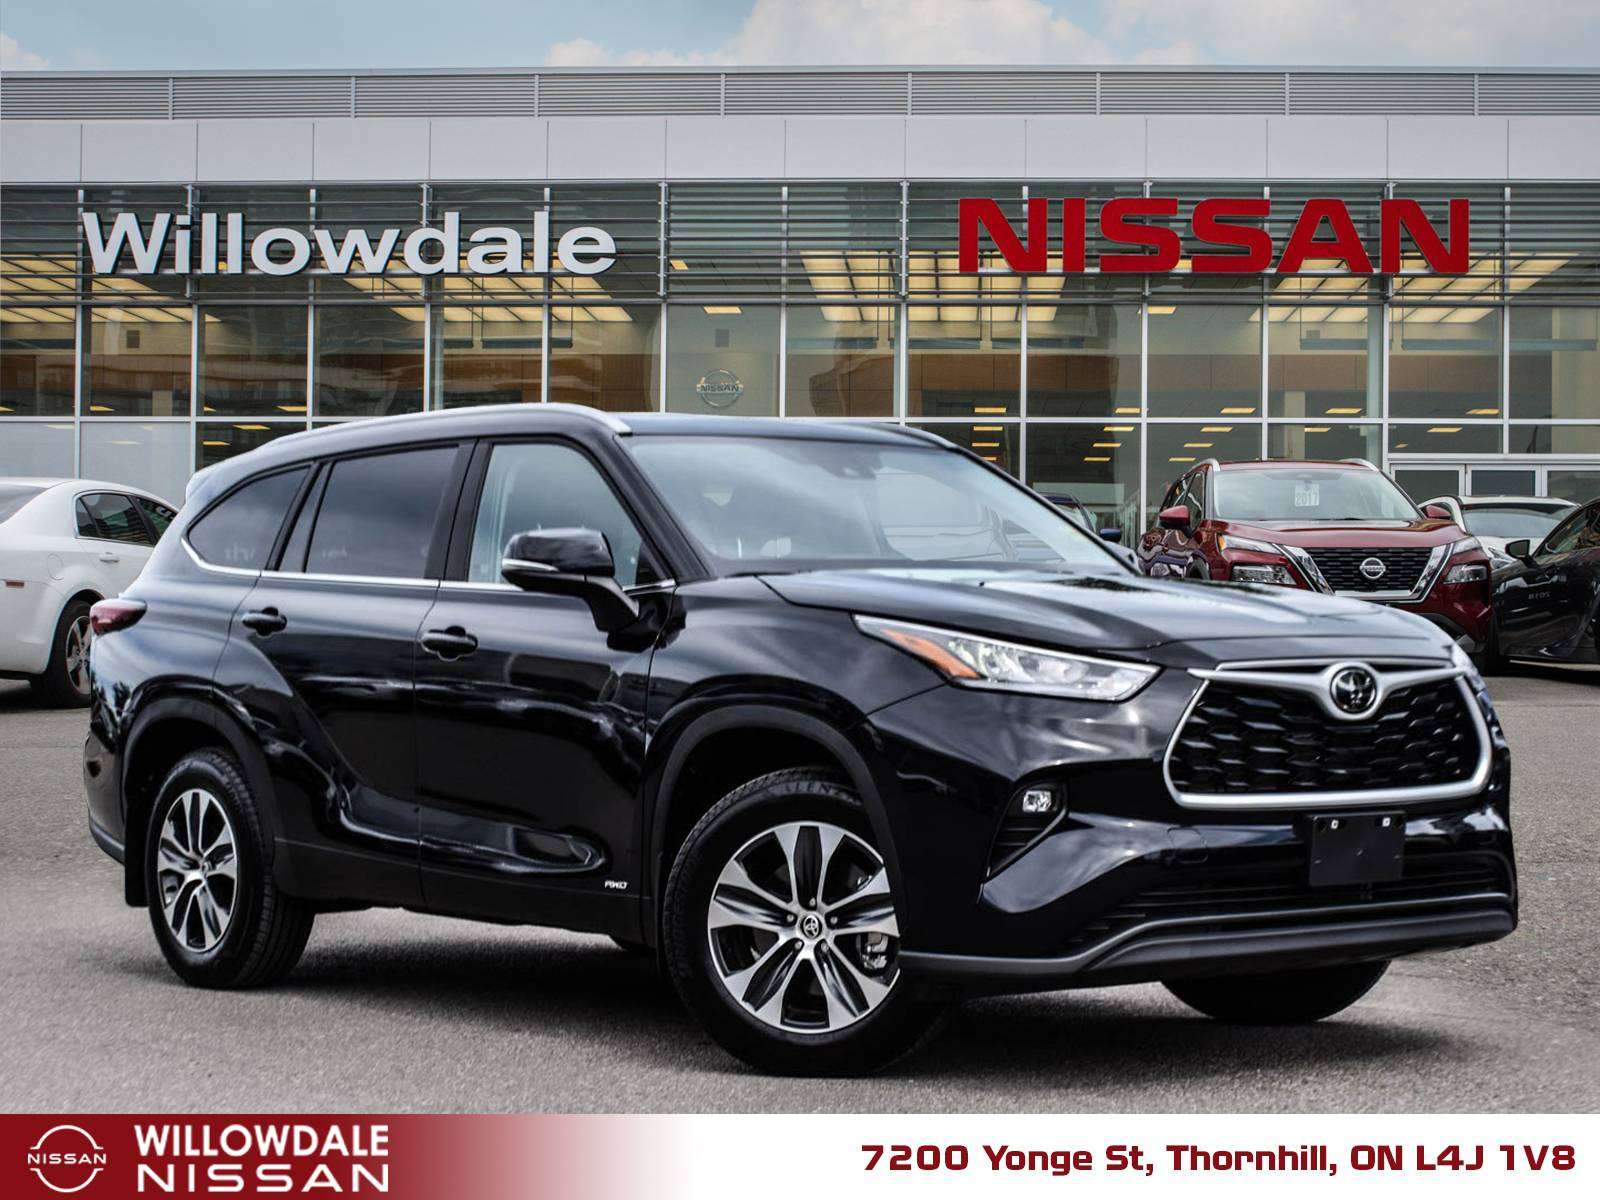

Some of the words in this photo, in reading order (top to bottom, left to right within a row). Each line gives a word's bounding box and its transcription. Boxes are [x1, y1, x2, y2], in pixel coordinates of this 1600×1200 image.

[82, 211, 617, 275] Willowdale
[958, 197, 1470, 274] NISSAN
[701, 383, 739, 393] NISSAN
[1295, 491, 1318, 506] 2017
